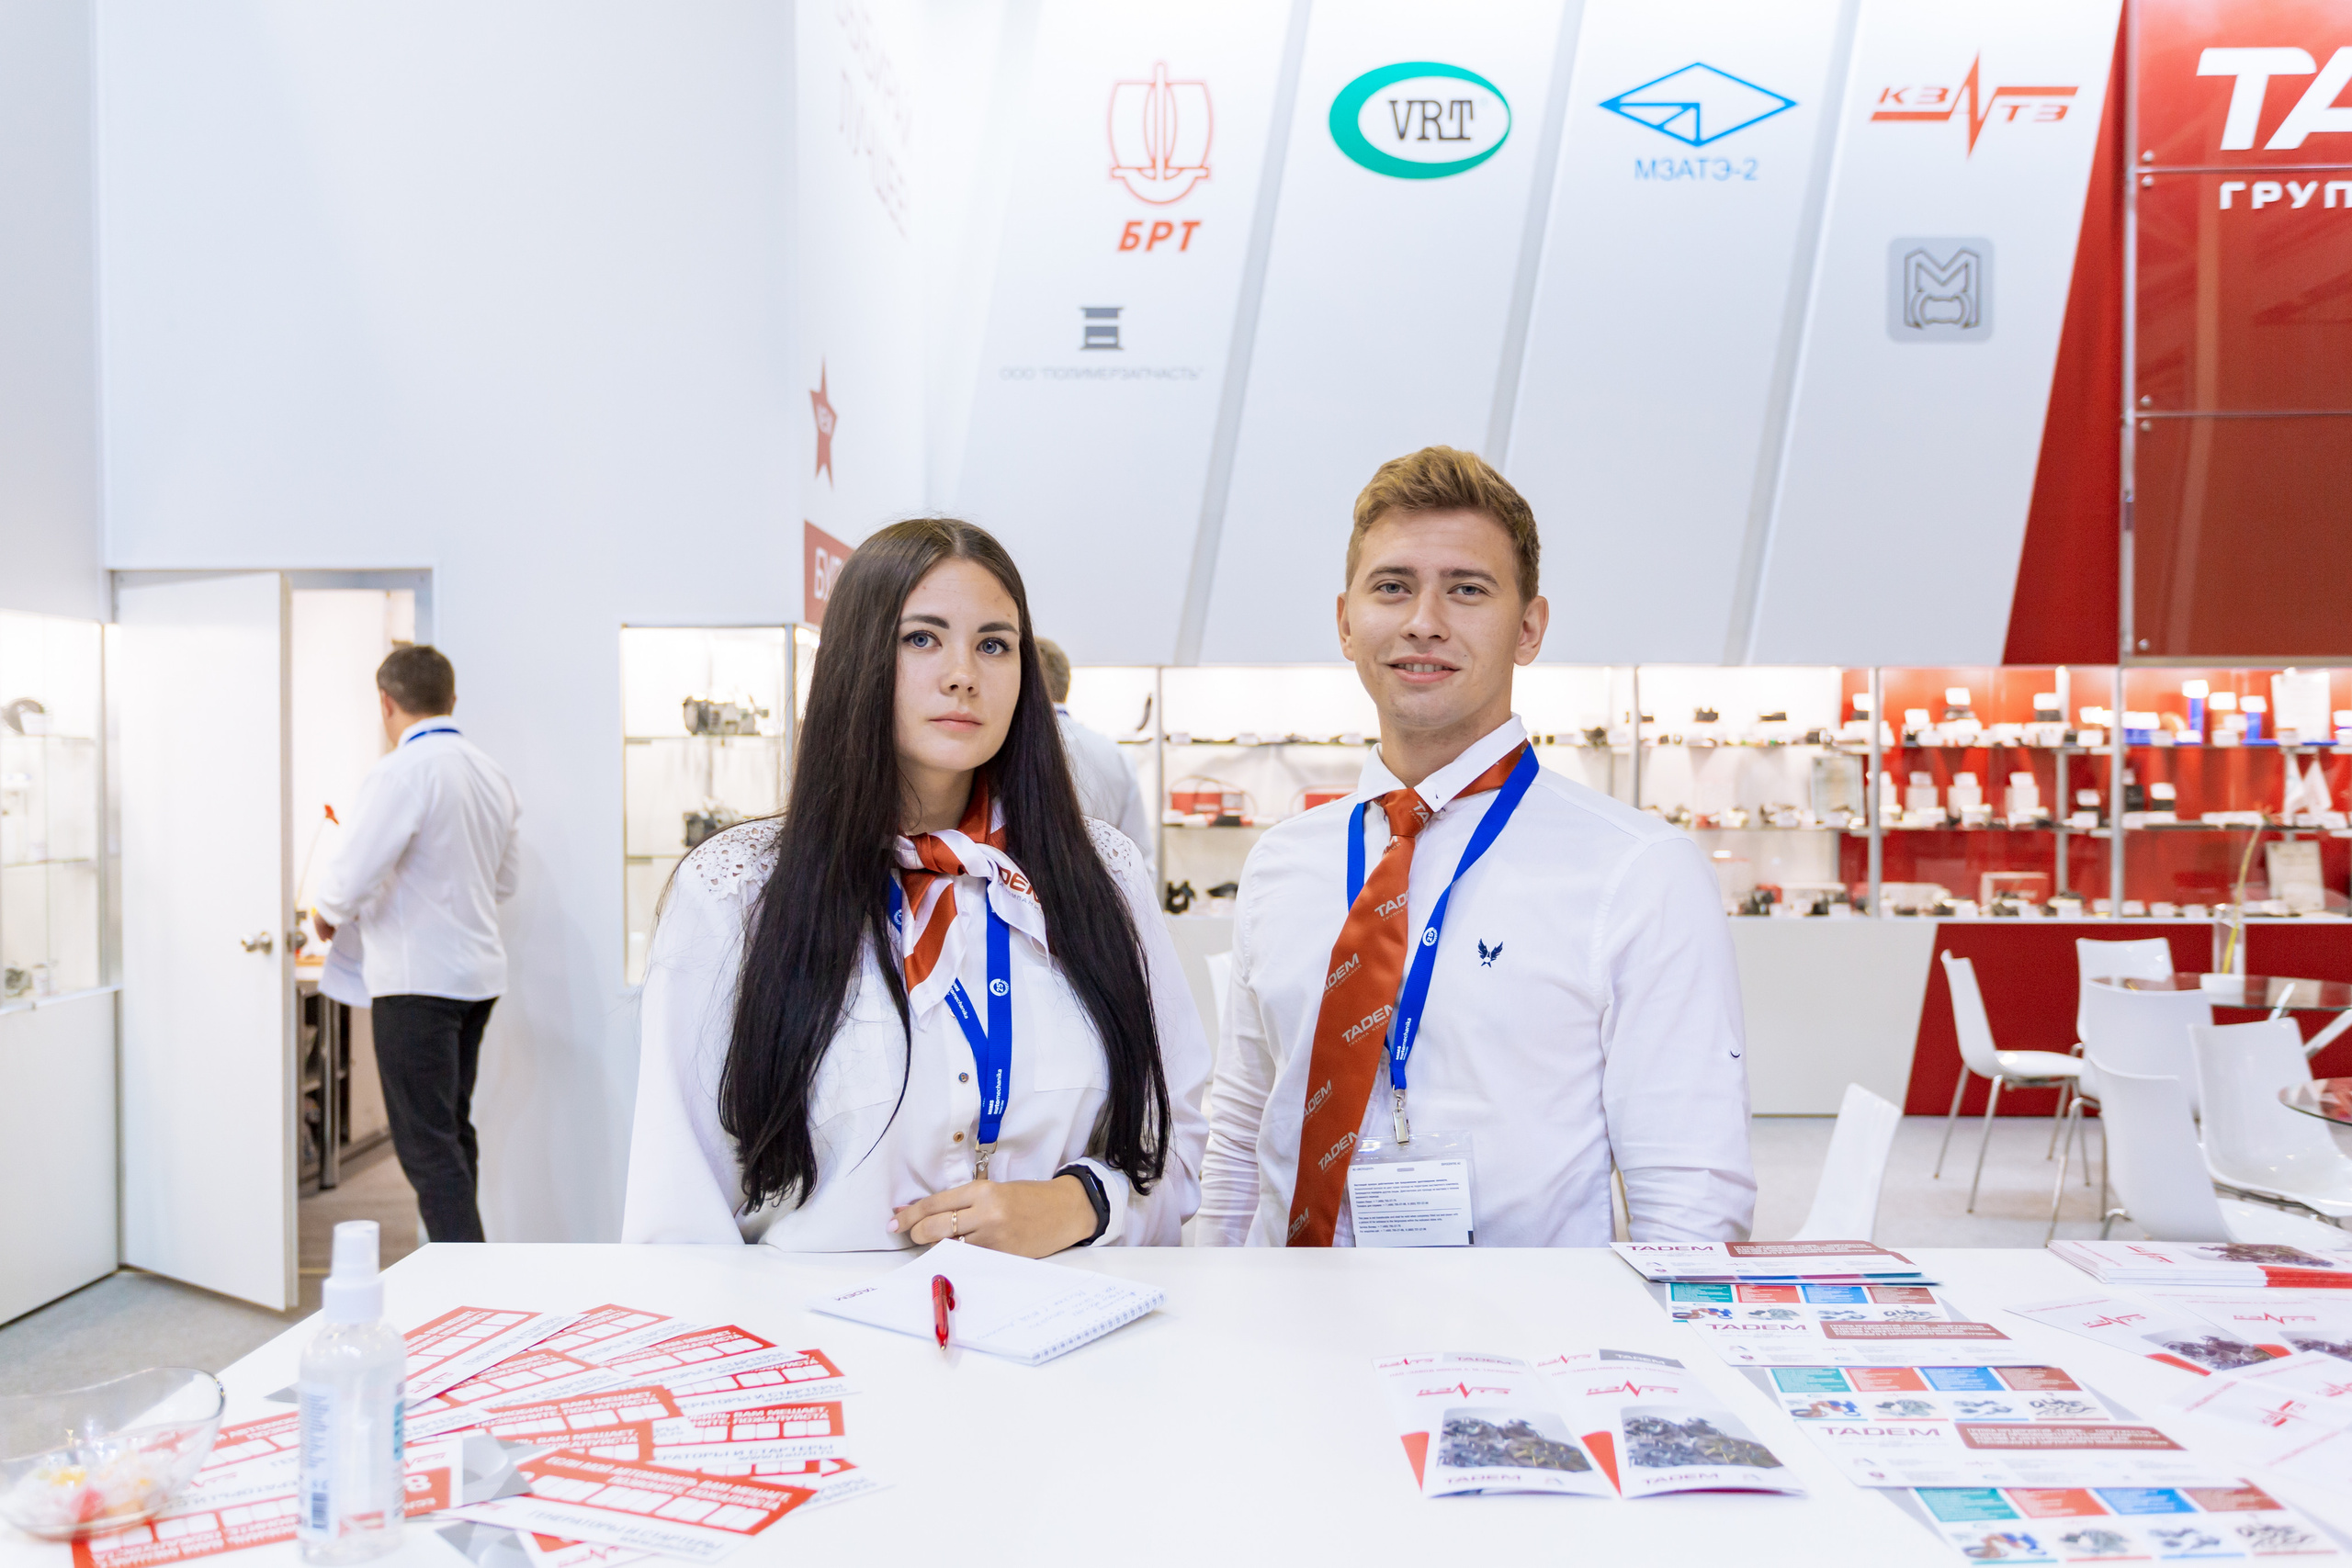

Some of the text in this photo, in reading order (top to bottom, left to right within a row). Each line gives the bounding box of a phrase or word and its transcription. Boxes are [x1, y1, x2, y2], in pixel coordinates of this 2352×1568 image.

[1388, 100, 1473, 141] VRT
[1635, 158, 1759, 182] МЗАТЭ-2
[1117, 220, 1201, 252] БРТ
[994, 1069, 1002, 1114] automechanika
[1819, 1427, 1941, 1437] TADEM
